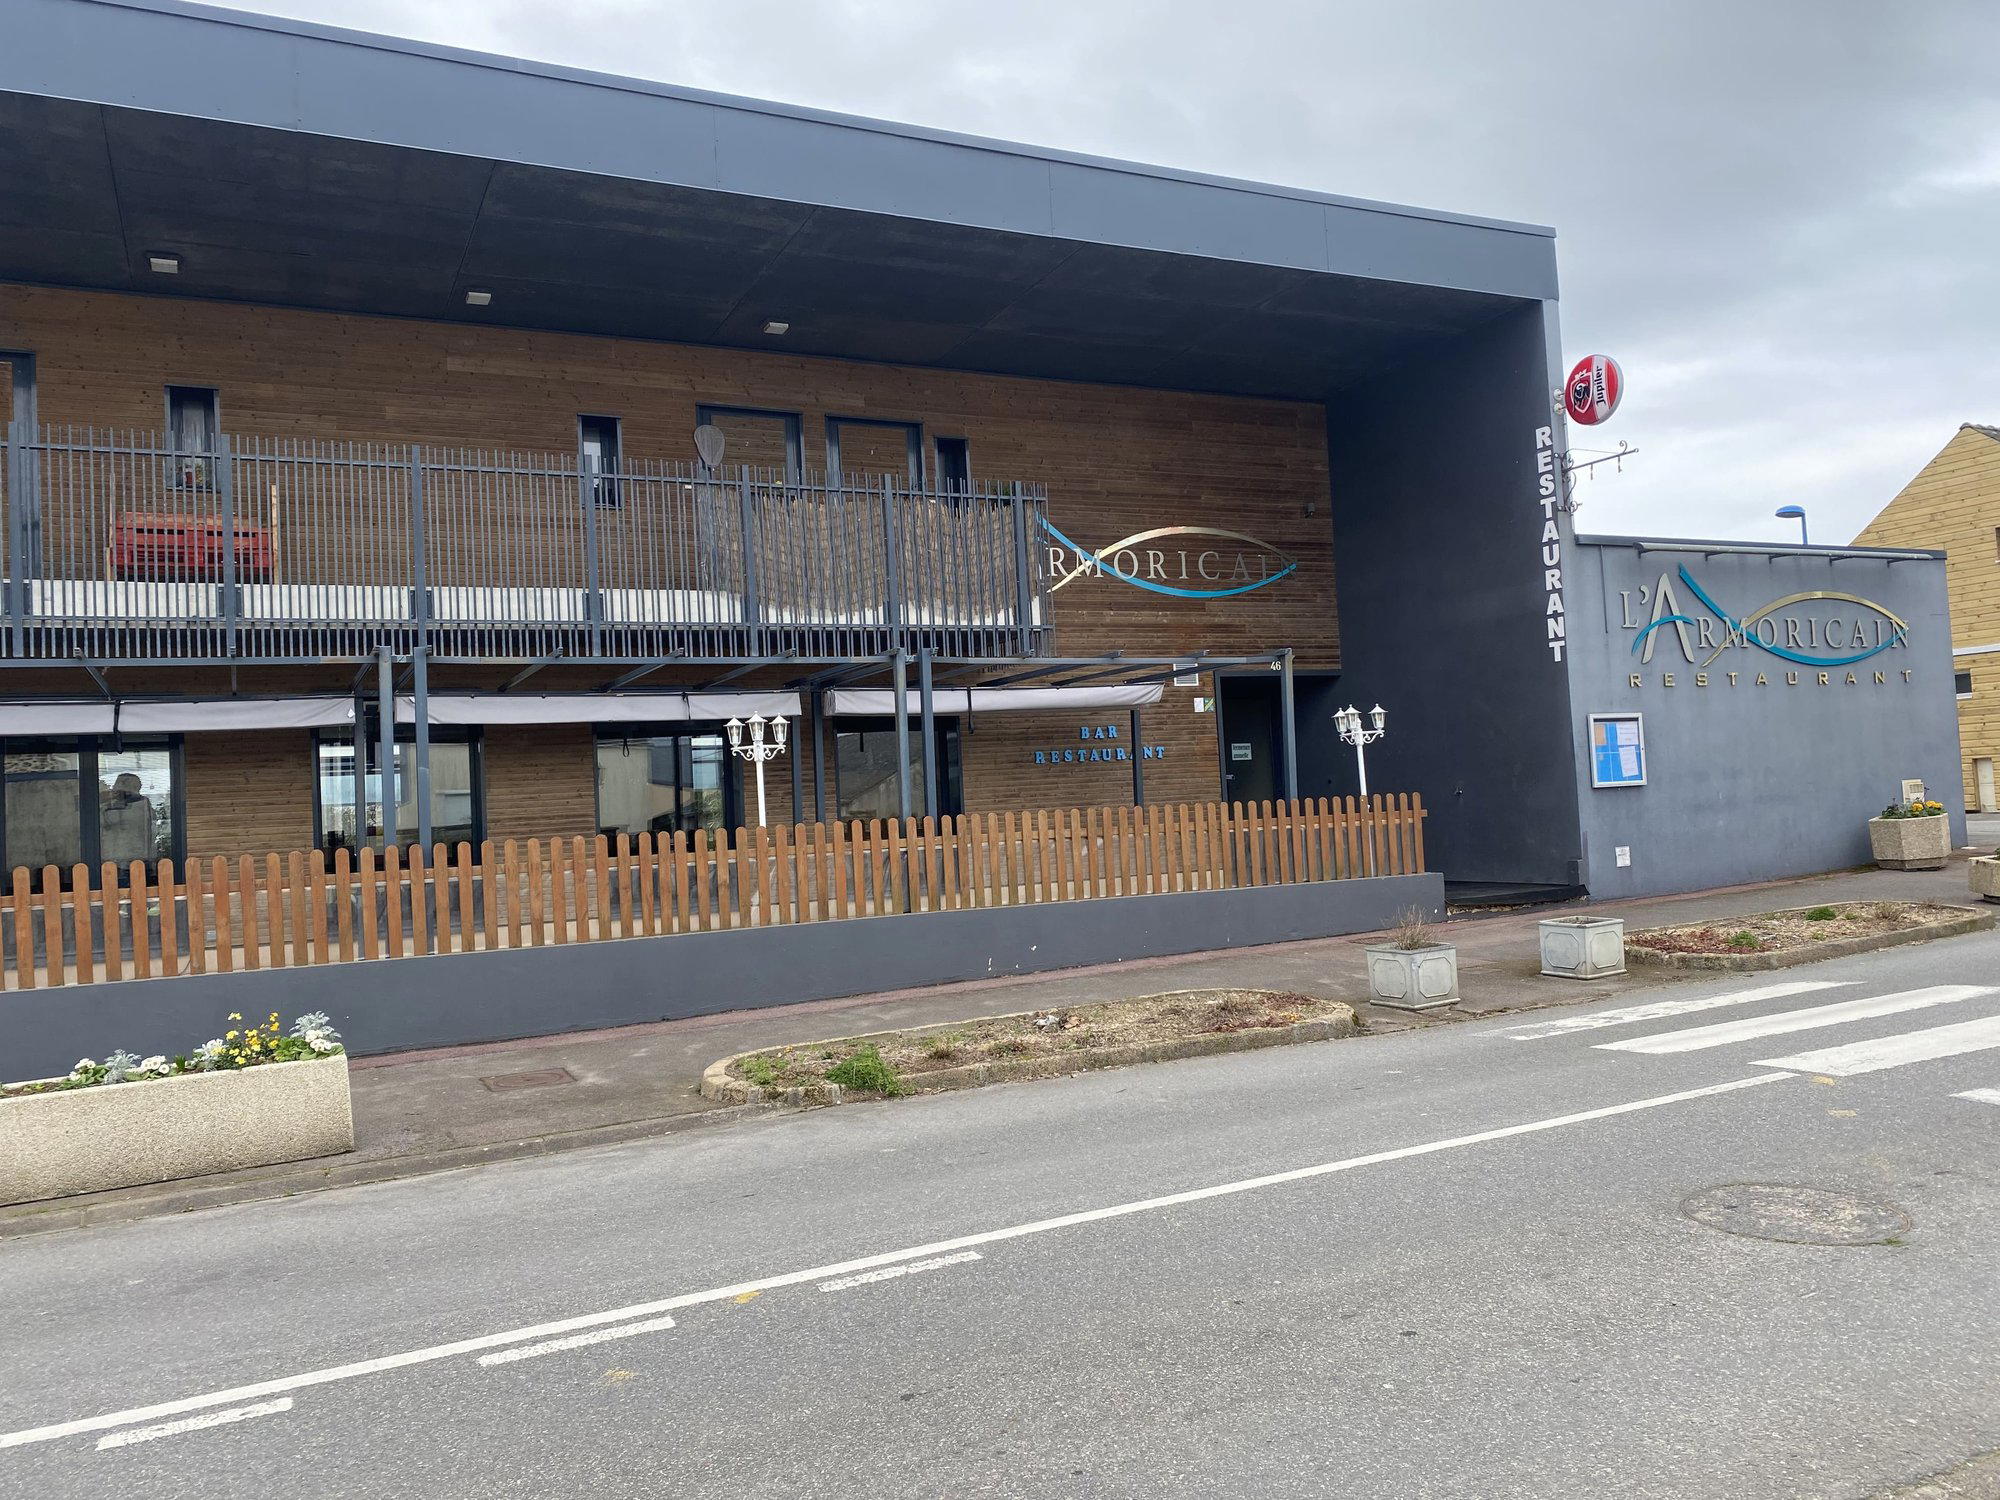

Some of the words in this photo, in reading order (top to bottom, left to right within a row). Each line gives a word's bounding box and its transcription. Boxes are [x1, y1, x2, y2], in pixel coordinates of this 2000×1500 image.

[1594, 365, 1607, 406] Jupiler
[1535, 425, 1566, 663] RESTAURANT
[1270, 660, 1282, 671] 46
[1628, 669, 1912, 688] RESTAURANT
[1079, 725, 1118, 739] BAR
[1033, 746, 1165, 765] RESTAURNT
